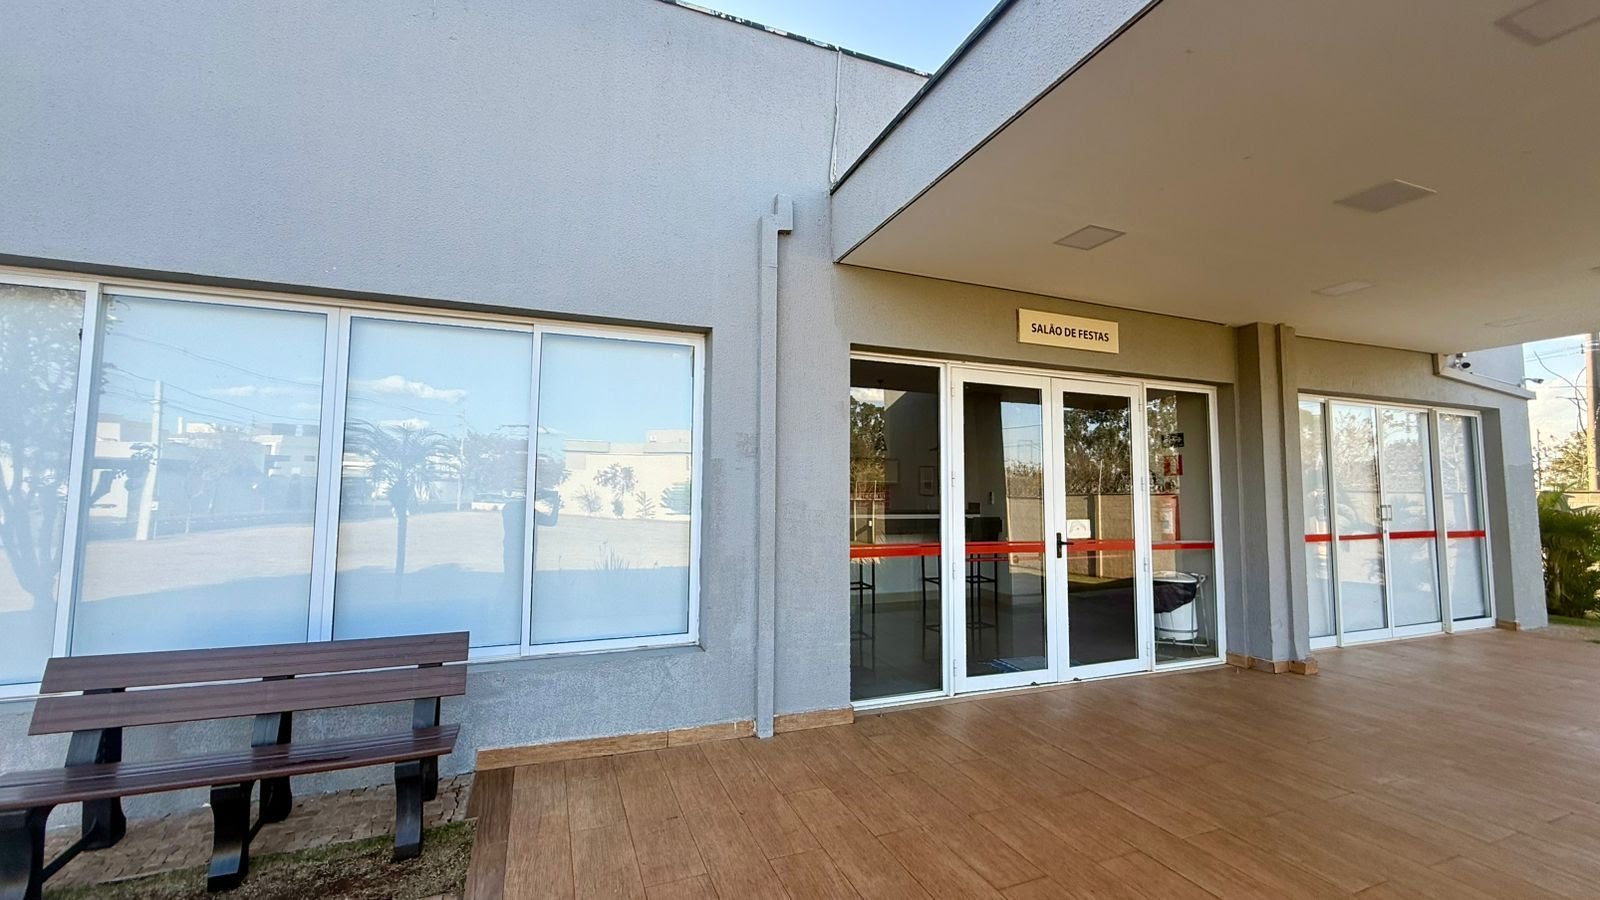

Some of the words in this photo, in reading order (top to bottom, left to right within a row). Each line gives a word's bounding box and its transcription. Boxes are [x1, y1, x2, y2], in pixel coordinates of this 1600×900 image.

[1031, 323, 1062, 336] SALÃO
[1064, 327, 1077, 338] DE
[1078, 329, 1109, 342] FESTAS
